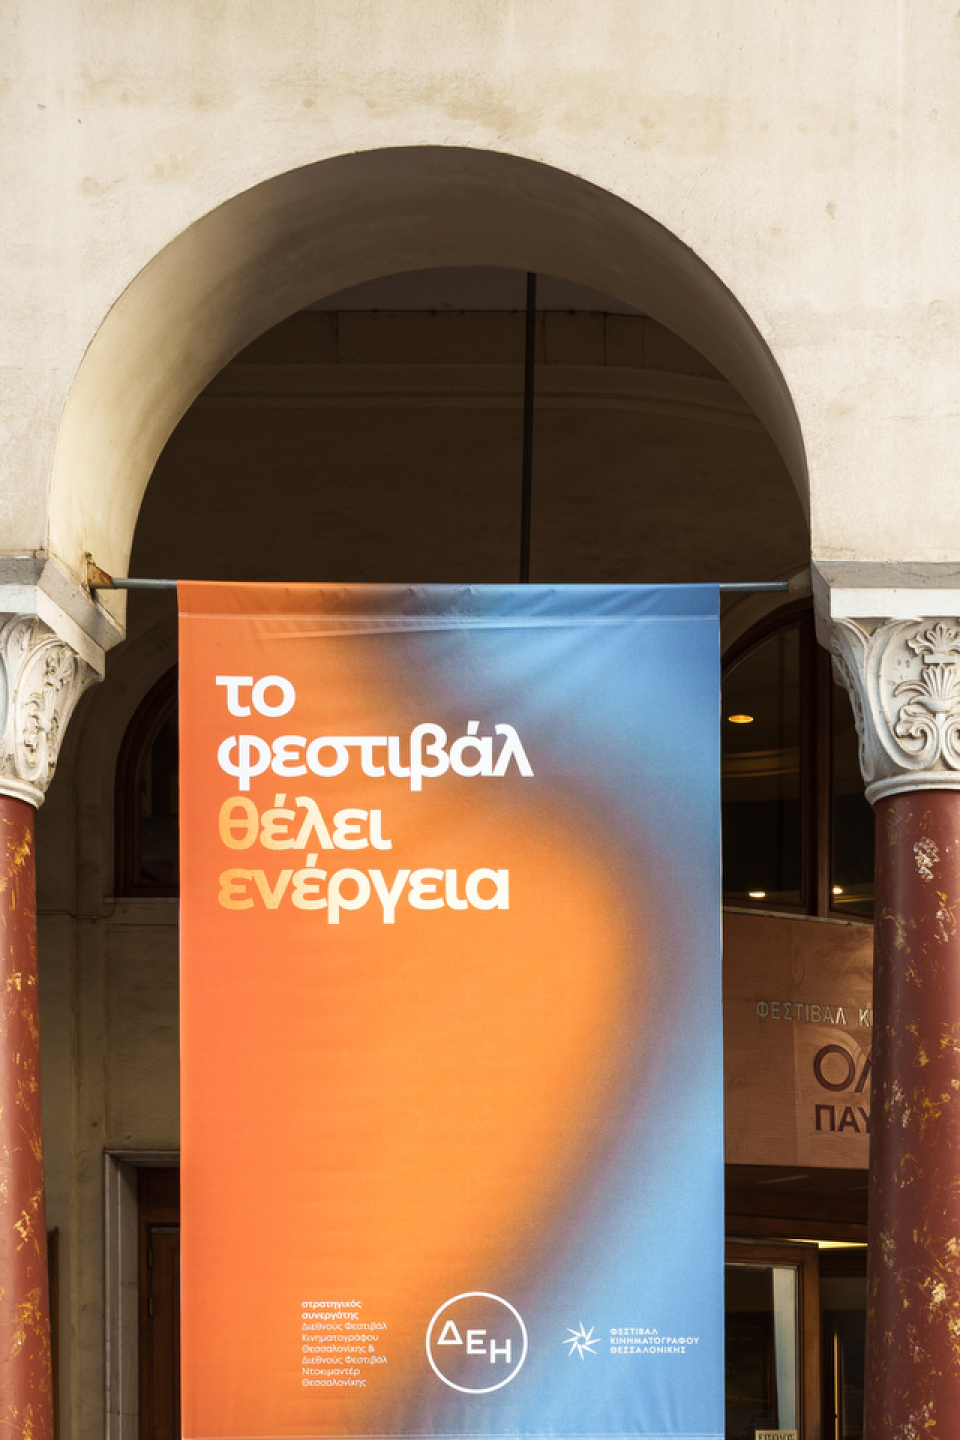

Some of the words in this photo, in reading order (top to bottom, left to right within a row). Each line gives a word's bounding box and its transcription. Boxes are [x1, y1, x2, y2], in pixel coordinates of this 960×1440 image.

[216, 674, 296, 718] το
[216, 719, 535, 792] φεστιβάλ
[218, 793, 393, 850] θέλει
[217, 853, 511, 925] ενέργεια
[756, 1000, 847, 1025] ΦΕΣΤΙΒΑΛ
[301, 1299, 362, 1310] στρατηγικός
[301, 1311, 359, 1320] συνεργάτης
[301, 1322, 343, 1332] Διεθνούς
[344, 1321, 387, 1332] Φεστιβάλ
[609, 1328, 658, 1336] ΦΕΣΤΙΒΑΛ
[301, 1333, 379, 1343] Κινηματογράφου
[437, 1319, 511, 1364] ΔΕΗ
[609, 1336, 700, 1345] ΚΙΝΗΜΑΤΟΓΡΑΦΟΥ
[301, 1344, 367, 1354] Θεσσαλονίκης
[368, 1344, 375, 1353] &
[609, 1346, 686, 1354] ΘΕΣΣΑΛΟΝΙΚΗΣ
[301, 1355, 343, 1365] Διεθνούς
[344, 1355, 387, 1366] Φεστιβάλ
[302, 1367, 361, 1377] Ντοκιμαντέρ
[301, 1378, 367, 1388] Θεσσαλονίκης
